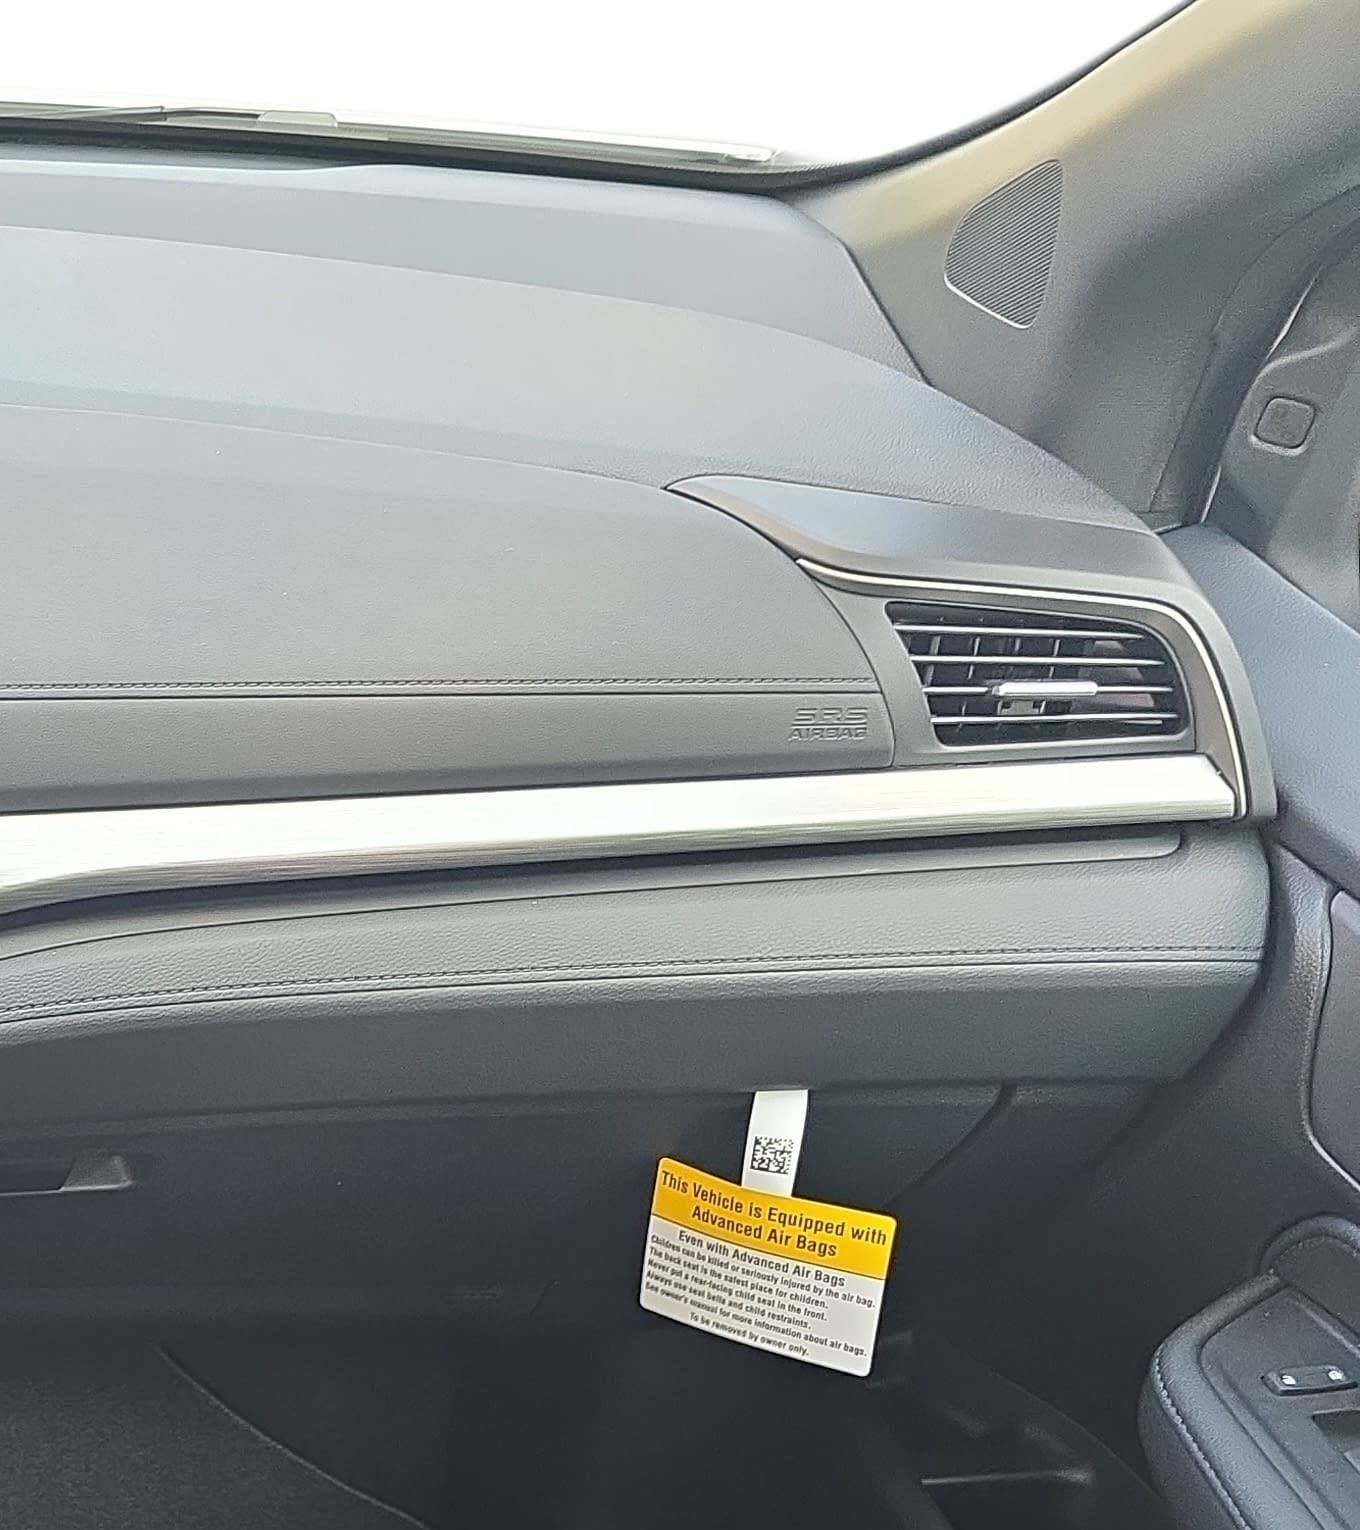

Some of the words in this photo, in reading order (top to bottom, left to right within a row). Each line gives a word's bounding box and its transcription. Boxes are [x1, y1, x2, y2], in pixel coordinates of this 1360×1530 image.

[792, 707, 868, 724] SRS
[662, 1170, 688, 1194] This
[693, 1182, 743, 1213] Vehicle
[749, 1202, 762, 1218] is
[767, 1207, 845, 1236] Equipped
[851, 1227, 887, 1245] with
[692, 1205, 762, 1239] Advanced
[767, 1228, 792, 1246] Air
[796, 1234, 837, 1257] Bags
[649, 1246, 663, 1258] The
[664, 1253, 681, 1263] back
[683, 1260, 699, 1272] seat
[701, 1264, 708, 1275] is
[710, 1268, 722, 1279] the
[724, 1274, 748, 1288] safest
[750, 1283, 773, 1295] place
[775, 1287, 788, 1298] for
[789, 1292, 828, 1309] children.
[651, 1234, 680, 1252] Children
[682, 1247, 695, 1258] can
[696, 1250, 706, 1261] be
[708, 1255, 729, 1269] killed
[731, 1264, 740, 1273] or
[741, 1266, 778, 1285] seriously
[780, 1276, 811, 1292] injured
[813, 1285, 824, 1296] by
[825, 1287, 840, 1299] the
[841, 1292, 854, 1302] air
[857, 1296, 876, 1308] bag.
[679, 1230, 703, 1248] Even
[706, 1239, 729, 1257] with
[732, 1249, 789, 1273] Advanced
[792, 1265, 812, 1279] Air
[815, 1270, 846, 1287] Bags
[648, 1258, 670, 1273] Never
[691, 1275, 733, 1296] rear-facing
[735, 1289, 755, 1302] child
[757, 1295, 775, 1307] seat
[777, 1300, 786, 1310] in
[788, 1303, 801, 1314] the
[803, 1307, 828, 1321] front.
[688, 1286, 706, 1297] seat
[707, 1291, 726, 1305] belts
[728, 1299, 743, 1310] and
[745, 1304, 766, 1317] child
[768, 1311, 811, 1329] restraints.
[711, 1320, 747, 1338] removed
[748, 1331, 759, 1343] by
[760, 1335, 787, 1349] owner
[788, 1344, 810, 1356] only.
[720, 1308, 731, 1318] for
[732, 1313, 753, 1325] more
[754, 1318, 802, 1339] information
[803, 1333, 828, 1347] about
[829, 1340, 842, 1350] air
[843, 1343, 867, 1357] bags.
